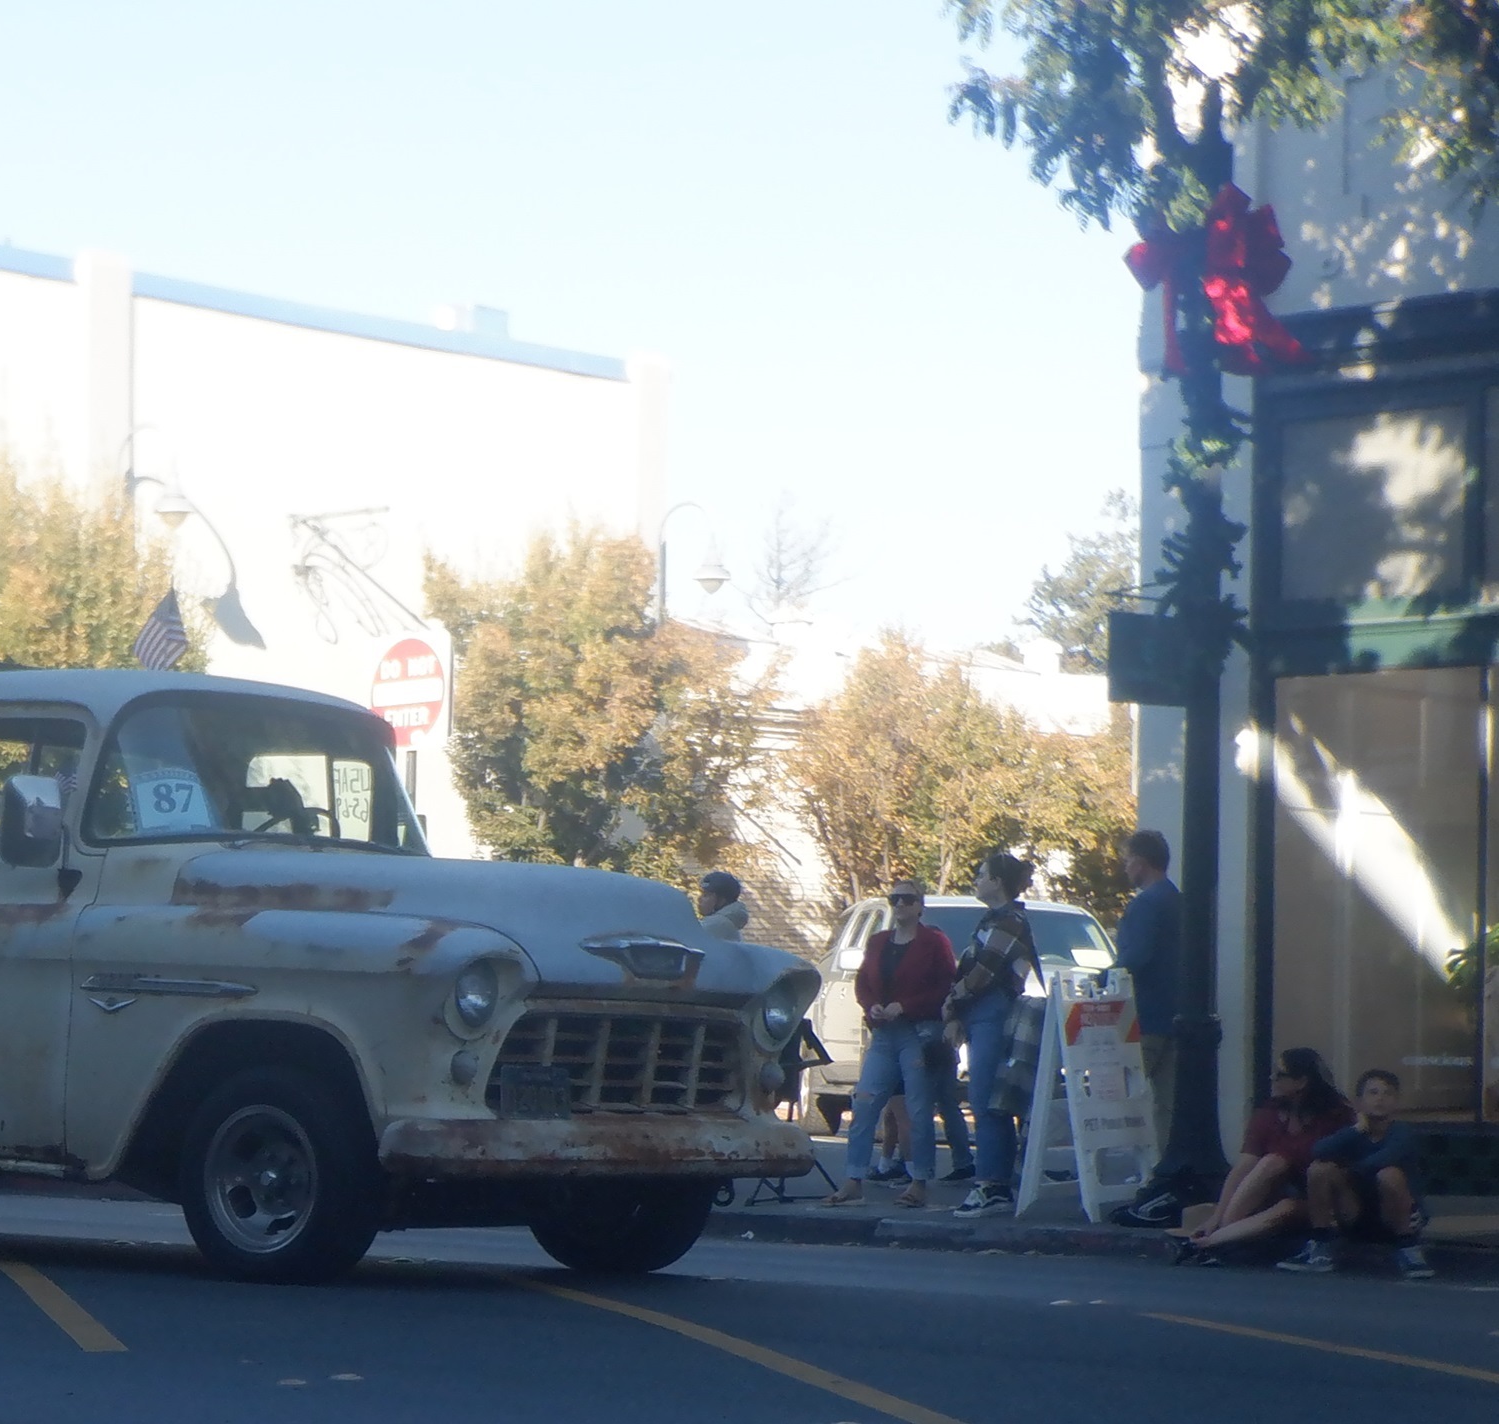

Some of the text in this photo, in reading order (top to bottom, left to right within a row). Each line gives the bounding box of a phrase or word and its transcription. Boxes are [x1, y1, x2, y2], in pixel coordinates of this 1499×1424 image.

[380, 655, 437, 680] DO NOT
[383, 705, 430, 728] ENTER
[152, 782, 194, 814] 87
